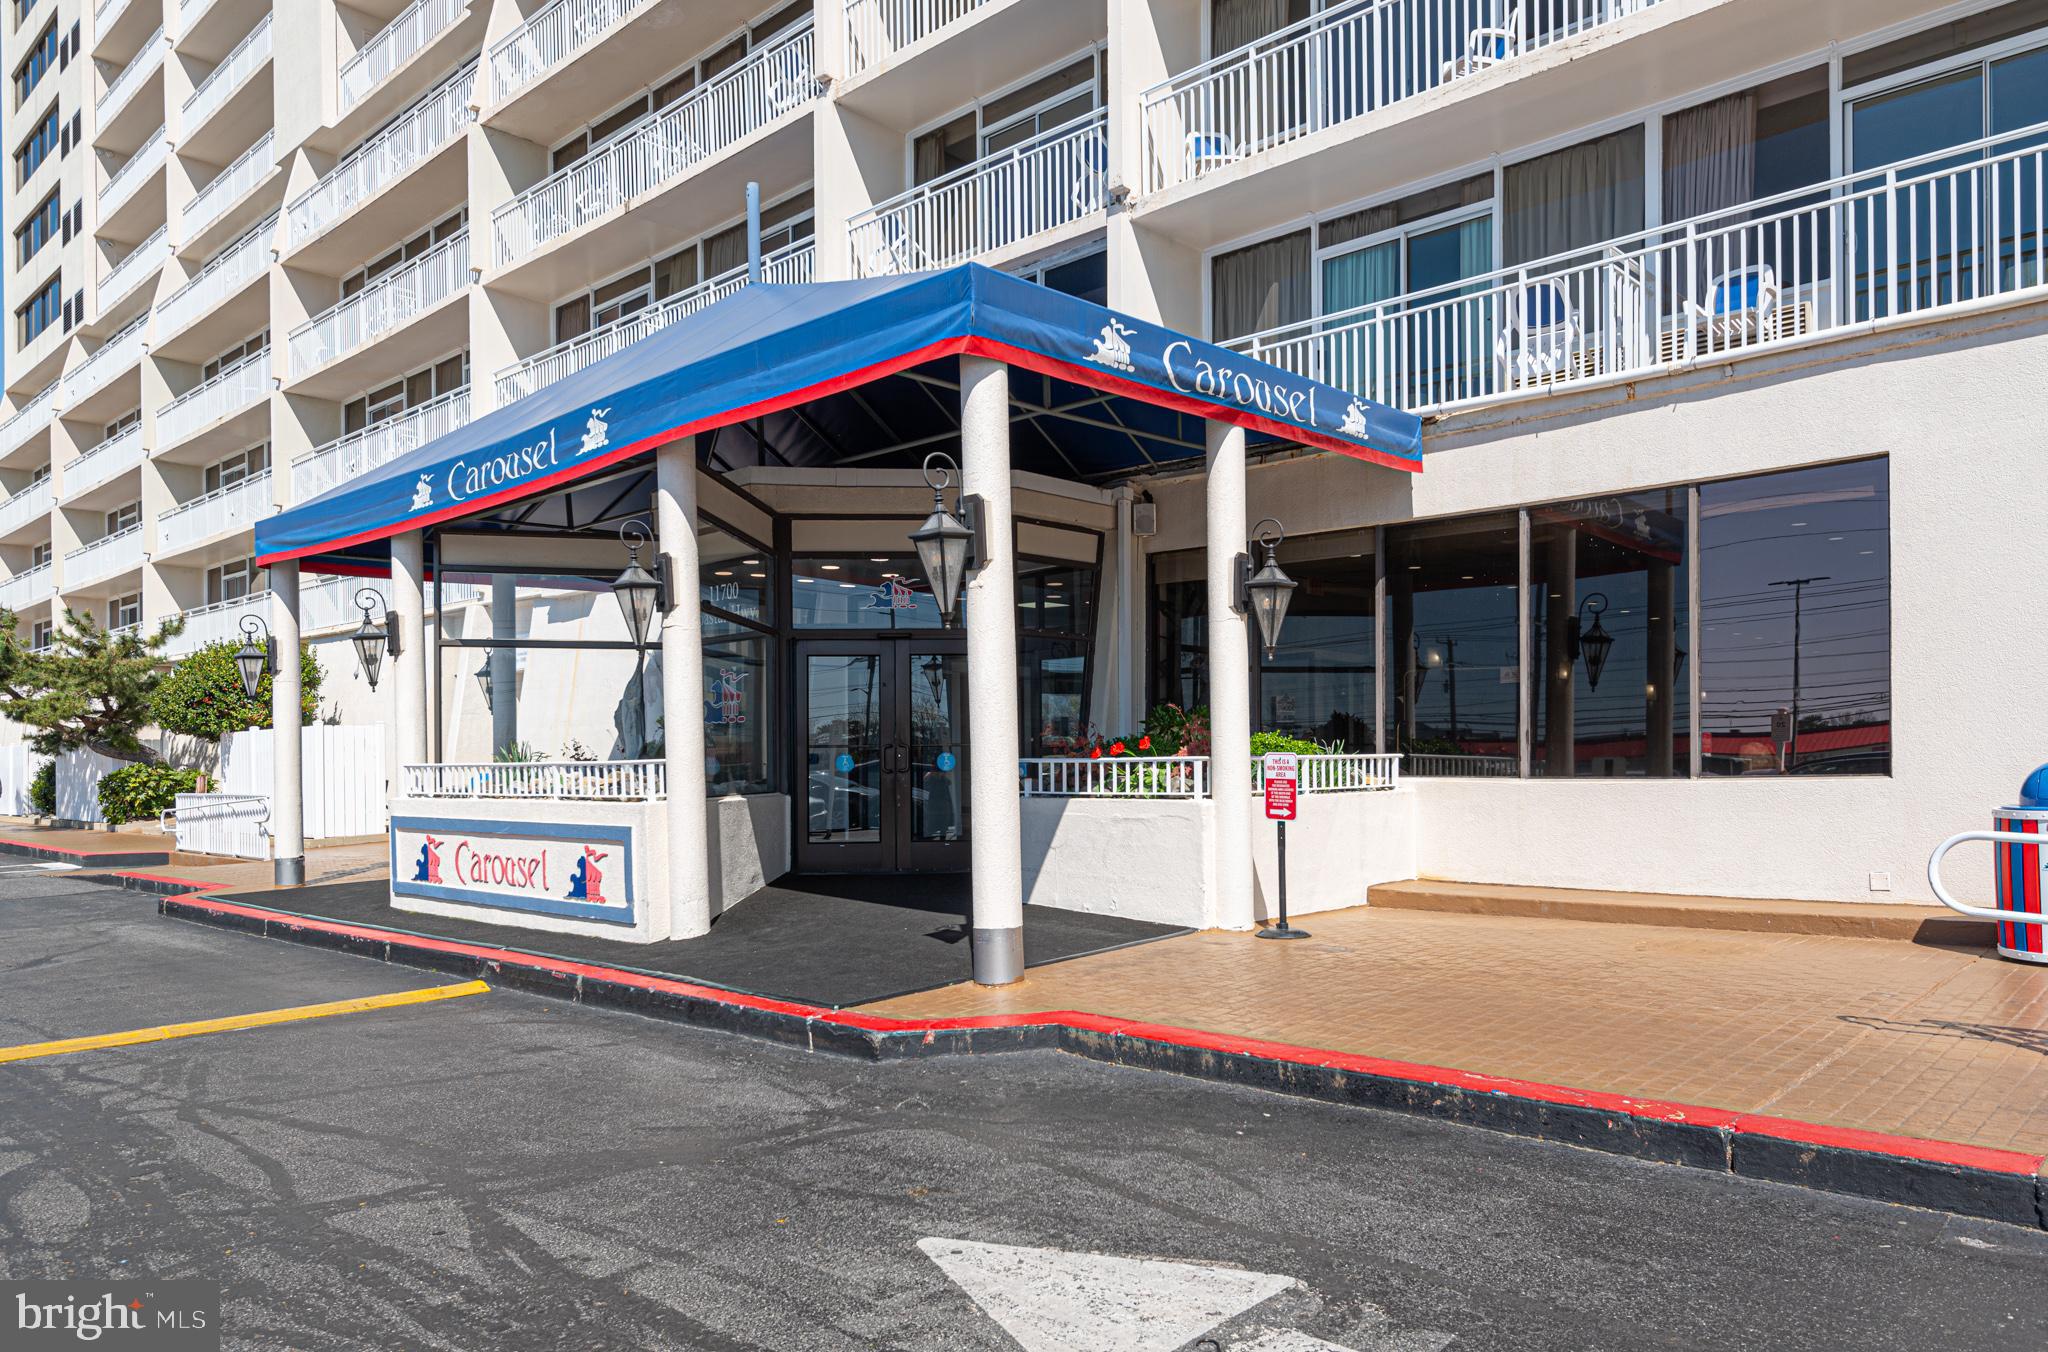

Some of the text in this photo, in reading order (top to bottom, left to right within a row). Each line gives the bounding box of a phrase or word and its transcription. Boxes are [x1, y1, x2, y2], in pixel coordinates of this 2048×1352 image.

[1163, 340, 1317, 427] Carousel
[447, 427, 558, 501] Carousel
[709, 582, 739, 601] 11700
[455, 840, 549, 891] Carousel
